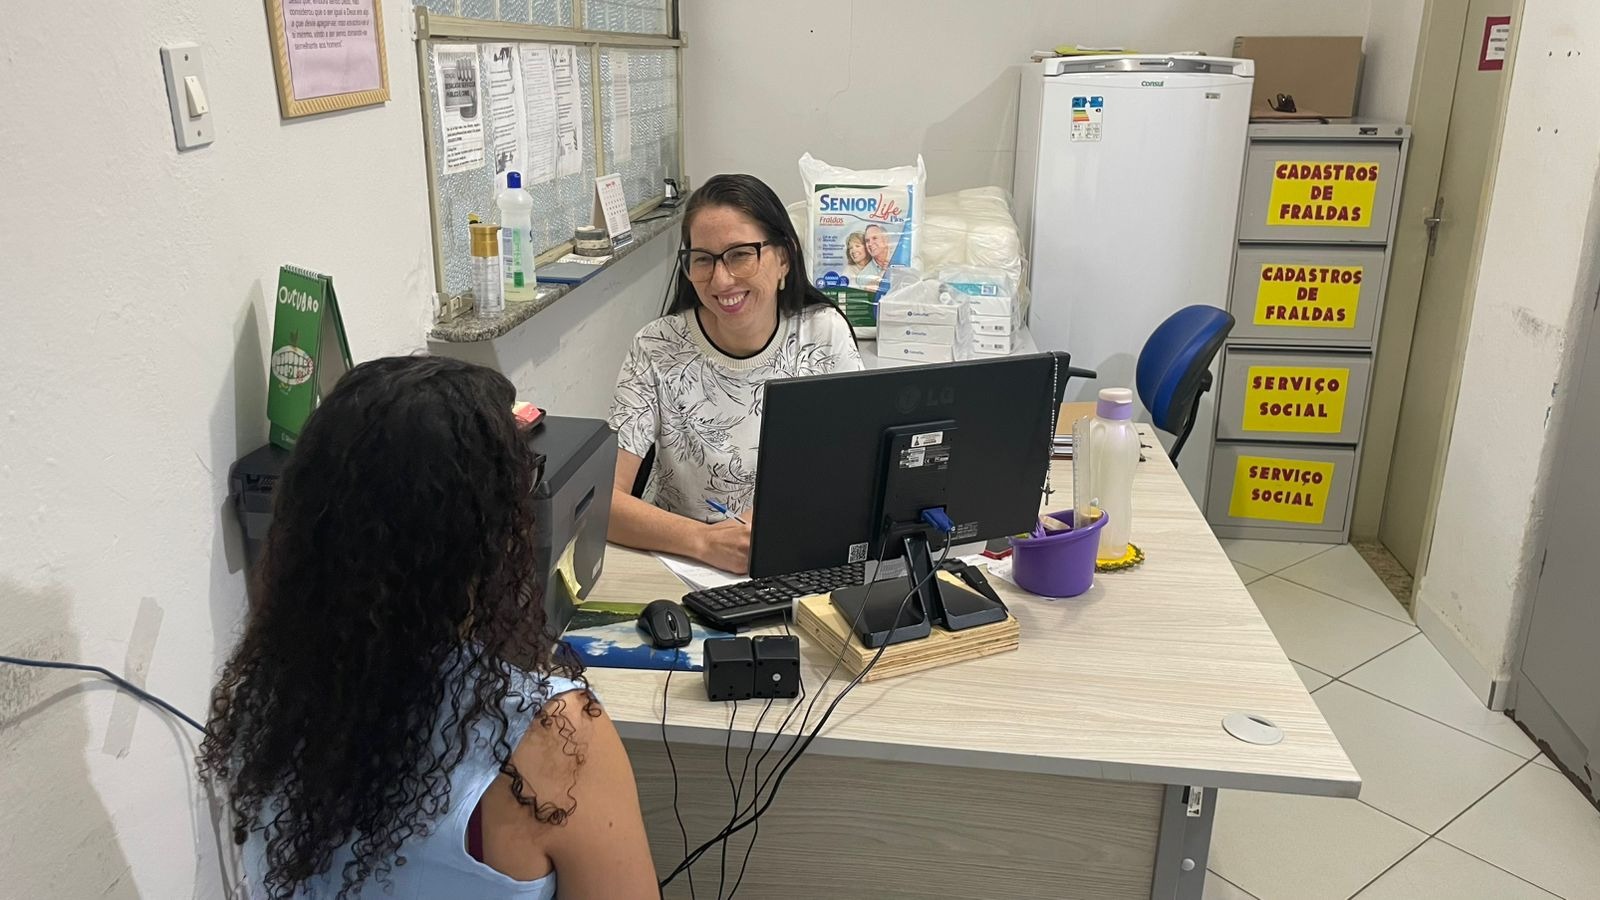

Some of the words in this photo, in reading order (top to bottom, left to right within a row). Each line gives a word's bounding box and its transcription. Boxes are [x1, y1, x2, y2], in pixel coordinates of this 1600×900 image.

[1276, 163, 1378, 182] CADASTROS
[1311, 185, 1334, 201] DE
[819, 194, 877, 212] SENIOR
[869, 193, 902, 221] Life
[1279, 203, 1362, 222] FRALDAS
[820, 216, 844, 224] Fraldas
[1262, 266, 1363, 285] CADASTROS
[1296, 286, 1319, 302] DE
[1265, 304, 1346, 322] FRALDAS
[1252, 375, 1340, 394] SERVIÇO
[1259, 401, 1328, 419] SOCIAL
[1249, 464, 1324, 486] SERVIÇO
[1250, 487, 1314, 508] SOCIAL
